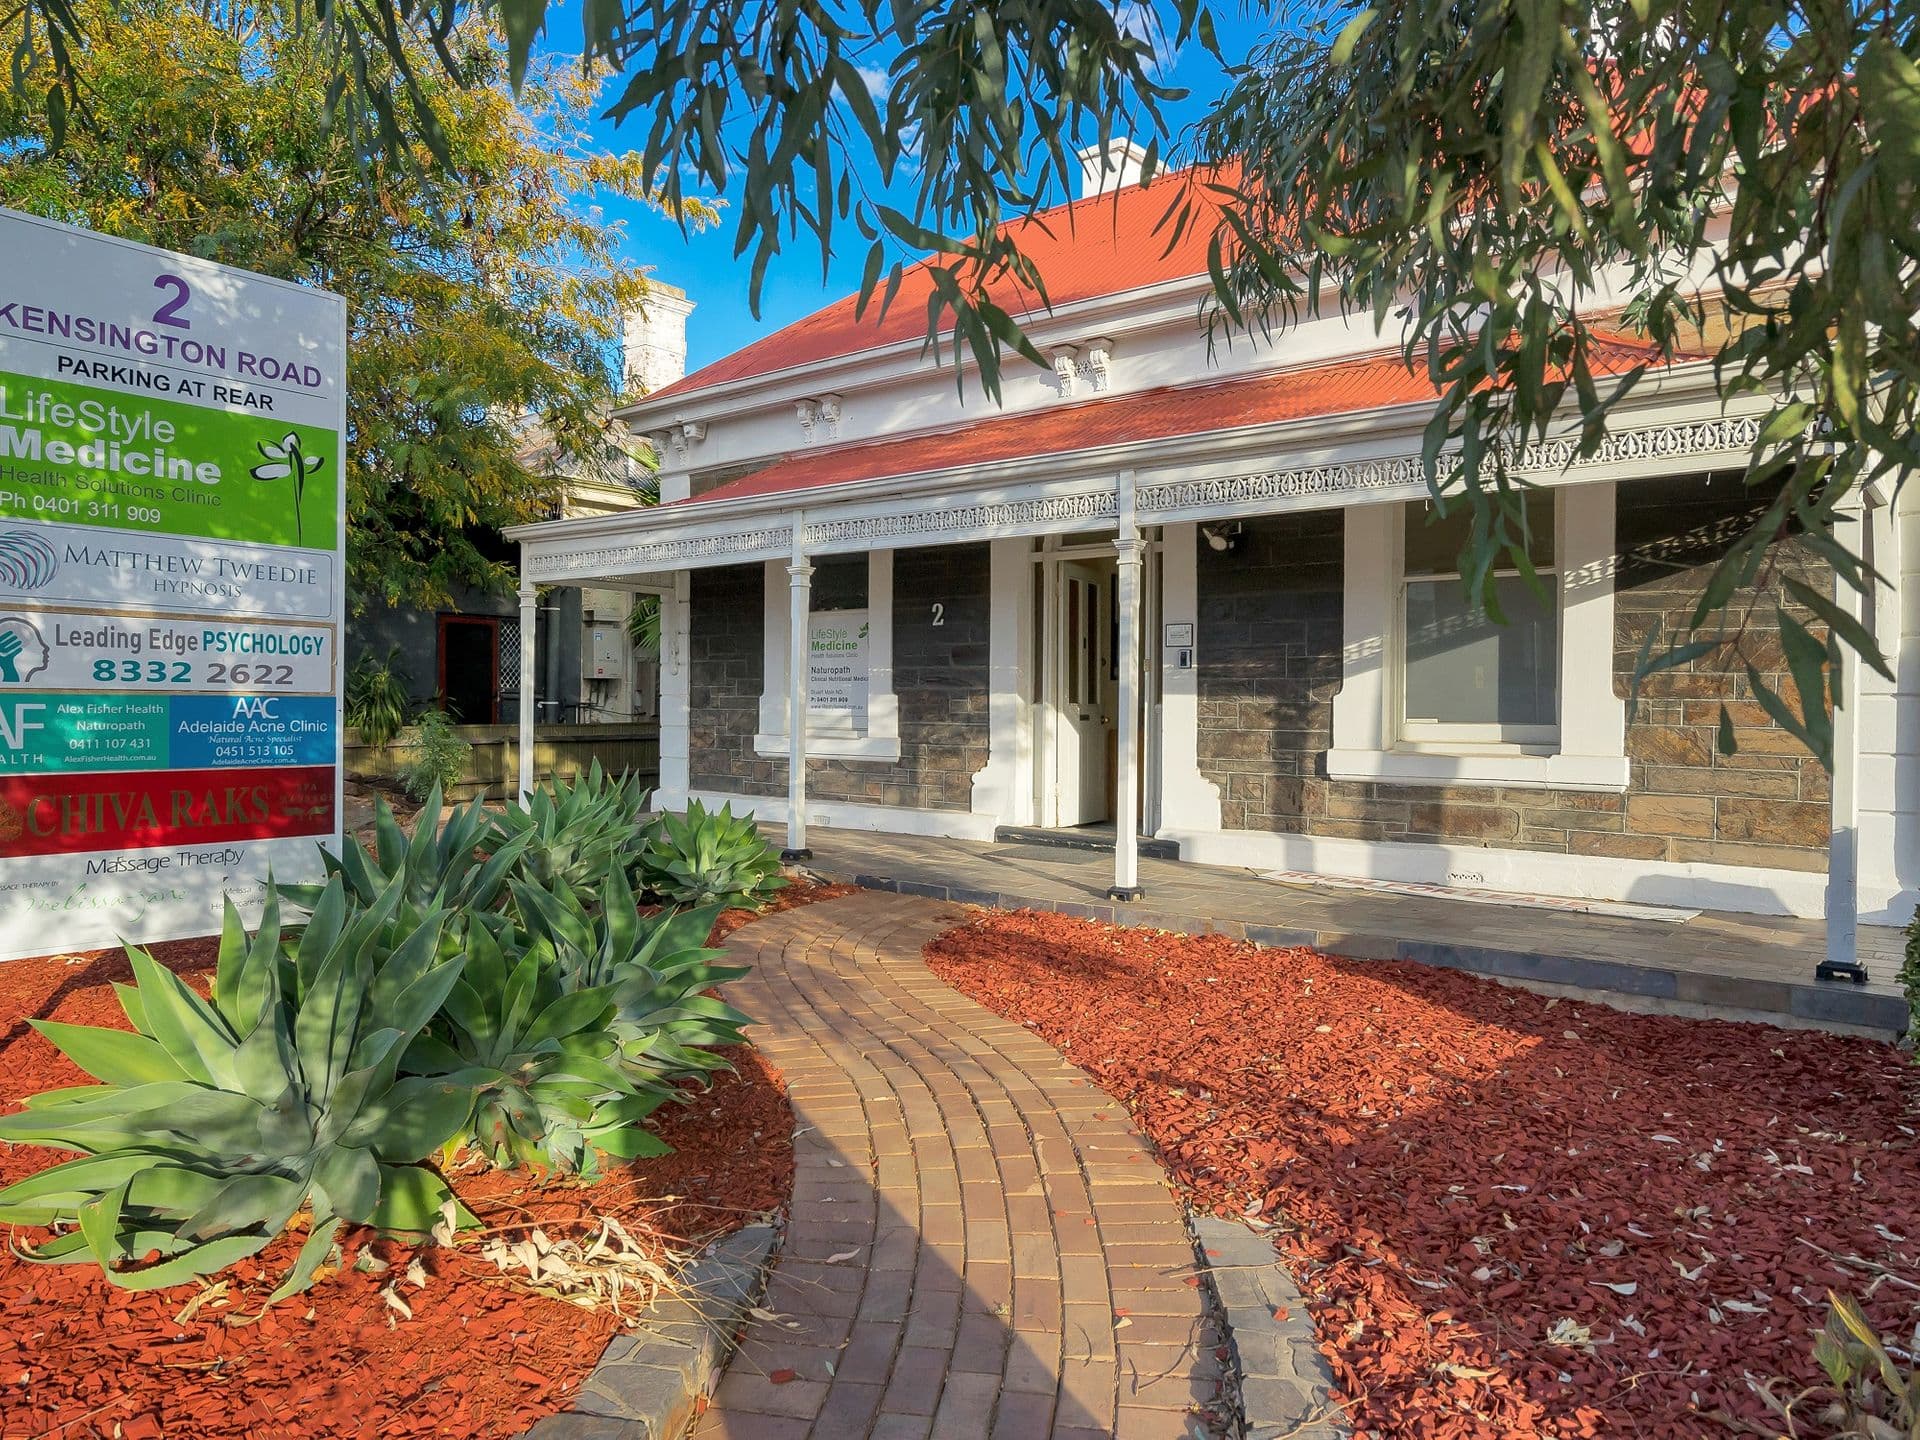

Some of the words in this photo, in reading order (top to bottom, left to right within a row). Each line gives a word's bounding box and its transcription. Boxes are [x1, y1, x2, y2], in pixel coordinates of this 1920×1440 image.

[153, 274, 191, 329] 2
[0, 302, 226, 369] KENSINGTON
[237, 352, 322, 388] ROAD
[57, 355, 171, 391] PARKING
[177, 380, 206, 398] AT
[213, 386, 274, 411] REAR
[0, 385, 175, 444] LifeStyle
[0, 424, 222, 484] Medicine
[0, 464, 67, 488] Health
[75, 474, 165, 500] Solutions
[172, 486, 222, 506] Clinic
[0, 490, 26, 508] Ph
[33, 495, 79, 514] 0401
[87, 502, 119, 519] 311
[127, 506, 161, 523] 909
[64, 543, 203, 575] MATTHEW
[214, 557, 317, 585] TWEEDIE
[154, 579, 243, 598] HYPNOSIS
[931, 603, 945, 626] 2
[55, 623, 142, 655] Leading
[150, 628, 198, 656] Edge
[203, 630, 324, 656] PSYCHOLOGY
[811, 628, 848, 641] LifeStyle
[811, 640, 858, 651] Medicine
[93, 659, 192, 683] 8332
[206, 663, 294, 685] 2622
[811, 666, 851, 675] Naturopath
[57, 703, 84, 714] Alex
[87, 703, 123, 714] Fisher
[126, 703, 164, 714] Health
[232, 697, 279, 719] AAC
[76, 720, 146, 732] Naturopath
[178, 720, 245, 734] Adelaide
[249, 720, 285, 733] Acne
[289, 719, 328, 733] Clinic
[69, 738, 100, 749] 0411
[106, 738, 127, 748] 107
[129, 738, 151, 748] 431
[208, 734, 242, 744] Natural
[267, 735, 303, 744] Specialist
[64, 754, 157, 763] AlexFisherHealth.com.au
[215, 746, 244, 757] 0451
[248, 745, 270, 756] 513
[274, 745, 294, 755] 105
[27, 791, 157, 837] CHIVA
[171, 786, 270, 829] RAKS
[86, 856, 171, 875] Massage
[176, 847, 245, 867] Therapy
